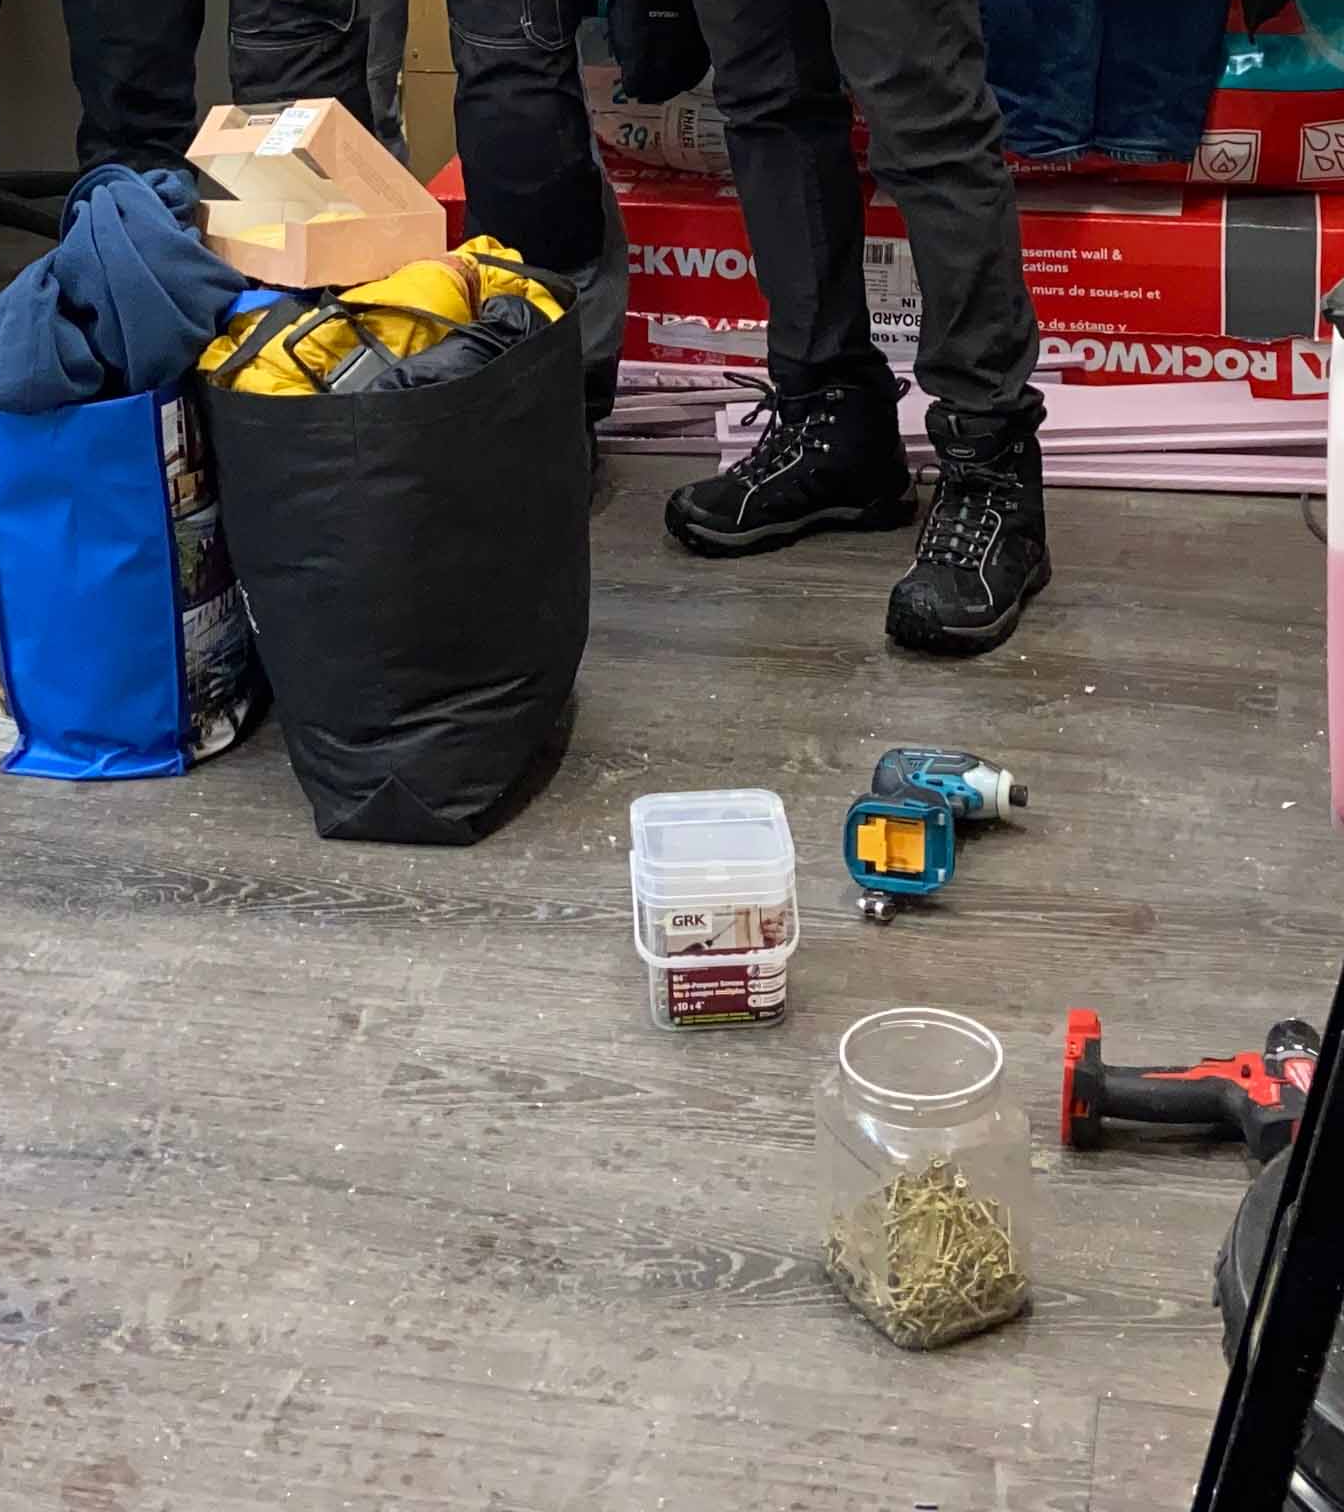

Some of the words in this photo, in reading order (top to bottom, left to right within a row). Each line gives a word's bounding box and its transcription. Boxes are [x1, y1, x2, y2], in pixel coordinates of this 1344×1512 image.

[628, 244, 758, 280] CKWO
[1081, 248, 1108, 260] wall
[1112, 249, 1123, 261] &
[1032, 285, 1065, 295] murs
[1069, 285, 1085, 297] de
[1089, 287, 1143, 299] sous-sol
[1146, 289, 1161, 300] et
[1049, 319, 1066, 330] de
[672, 913, 707, 928] GRK
